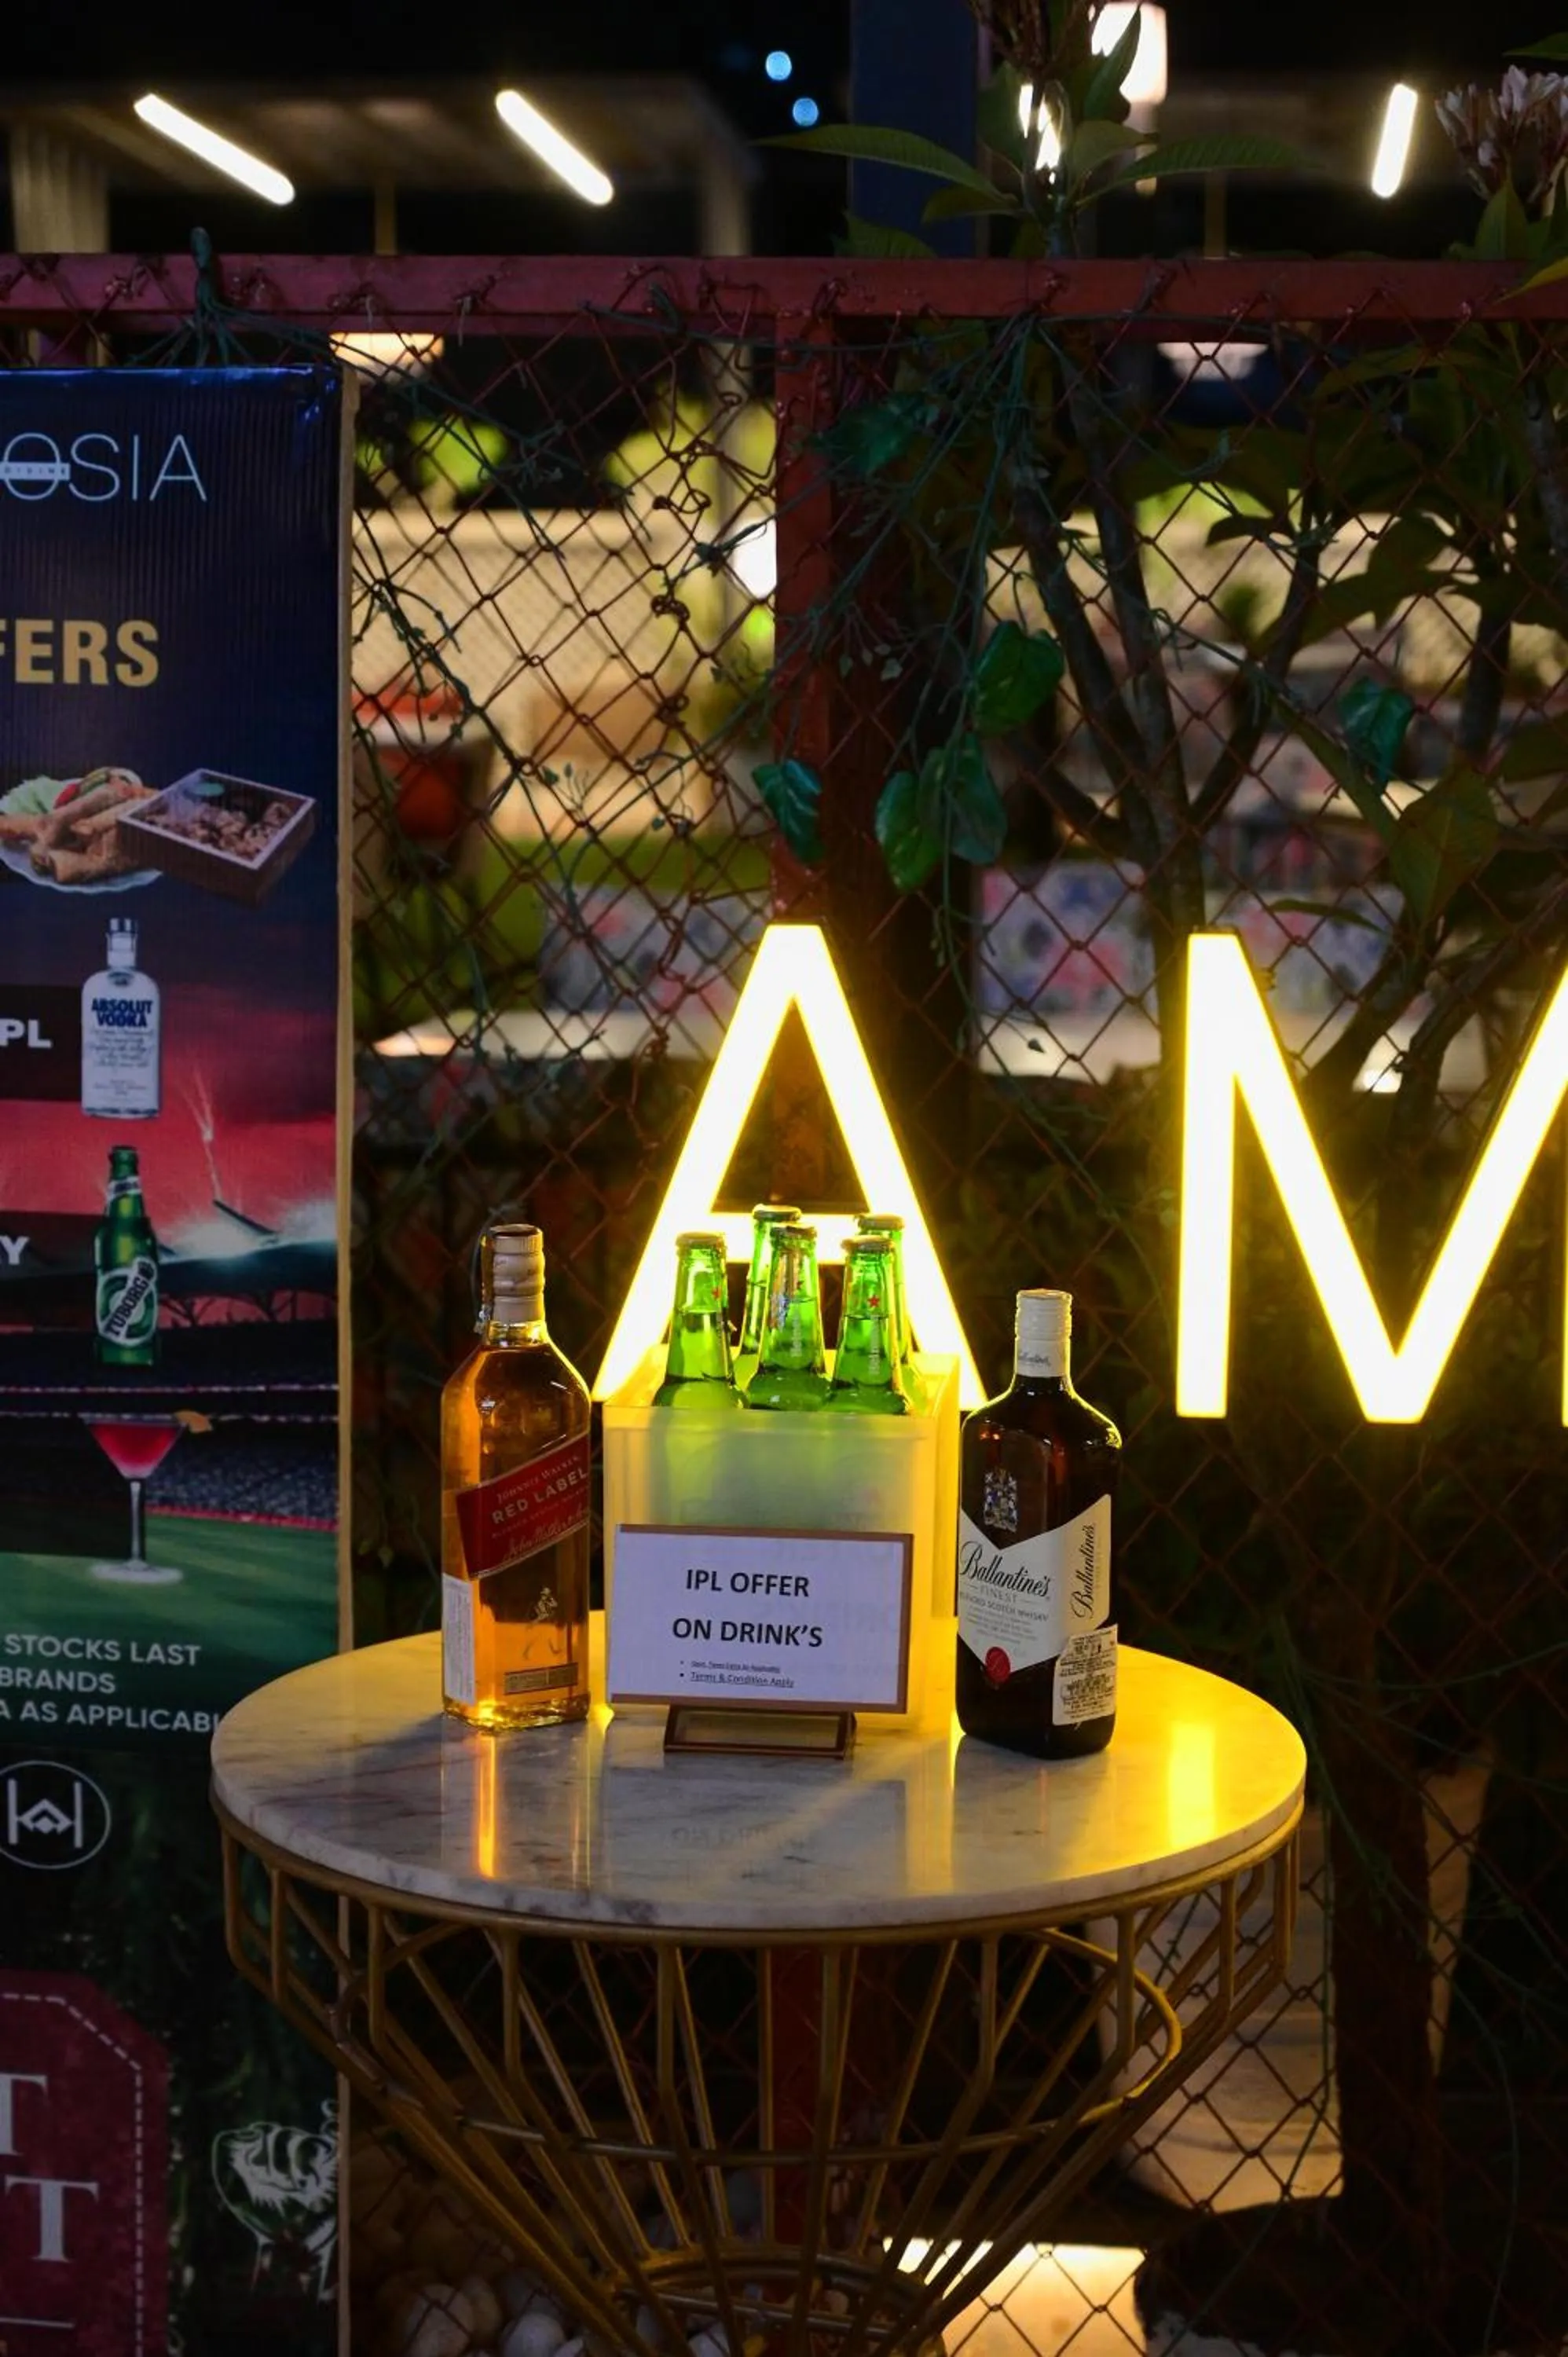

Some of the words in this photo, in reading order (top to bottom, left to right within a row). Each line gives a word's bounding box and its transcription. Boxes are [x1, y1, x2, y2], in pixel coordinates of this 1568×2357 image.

[2, 433, 207, 501] OSIA
[0, 618, 159, 687] ERS
[91, 998, 152, 1014] ABSOLUT
[97, 1010, 147, 1027] VODKA
[0, 1235, 29, 1265] Y
[103, 1275, 149, 1336] TUBORG
[492, 1498, 529, 1524] RED
[533, 1467, 588, 1502] LABEL
[685, 1568, 723, 1593] IPL
[729, 1571, 810, 1597] OFFER
[958, 1540, 1050, 1596] Ballantine's
[1069, 1523, 1094, 1619] Ballantine's
[672, 1617, 712, 1640] ON
[720, 1620, 823, 1648] DRINK'S
[5, 1633, 122, 1662] STOCKS
[130, 1641, 201, 1666] LAST
[0, 1666, 116, 1695] BRANDS
[691, 1671, 716, 1683] Terms
[20, 1700, 59, 1724] AS
[5, 2175, 100, 2263] T
